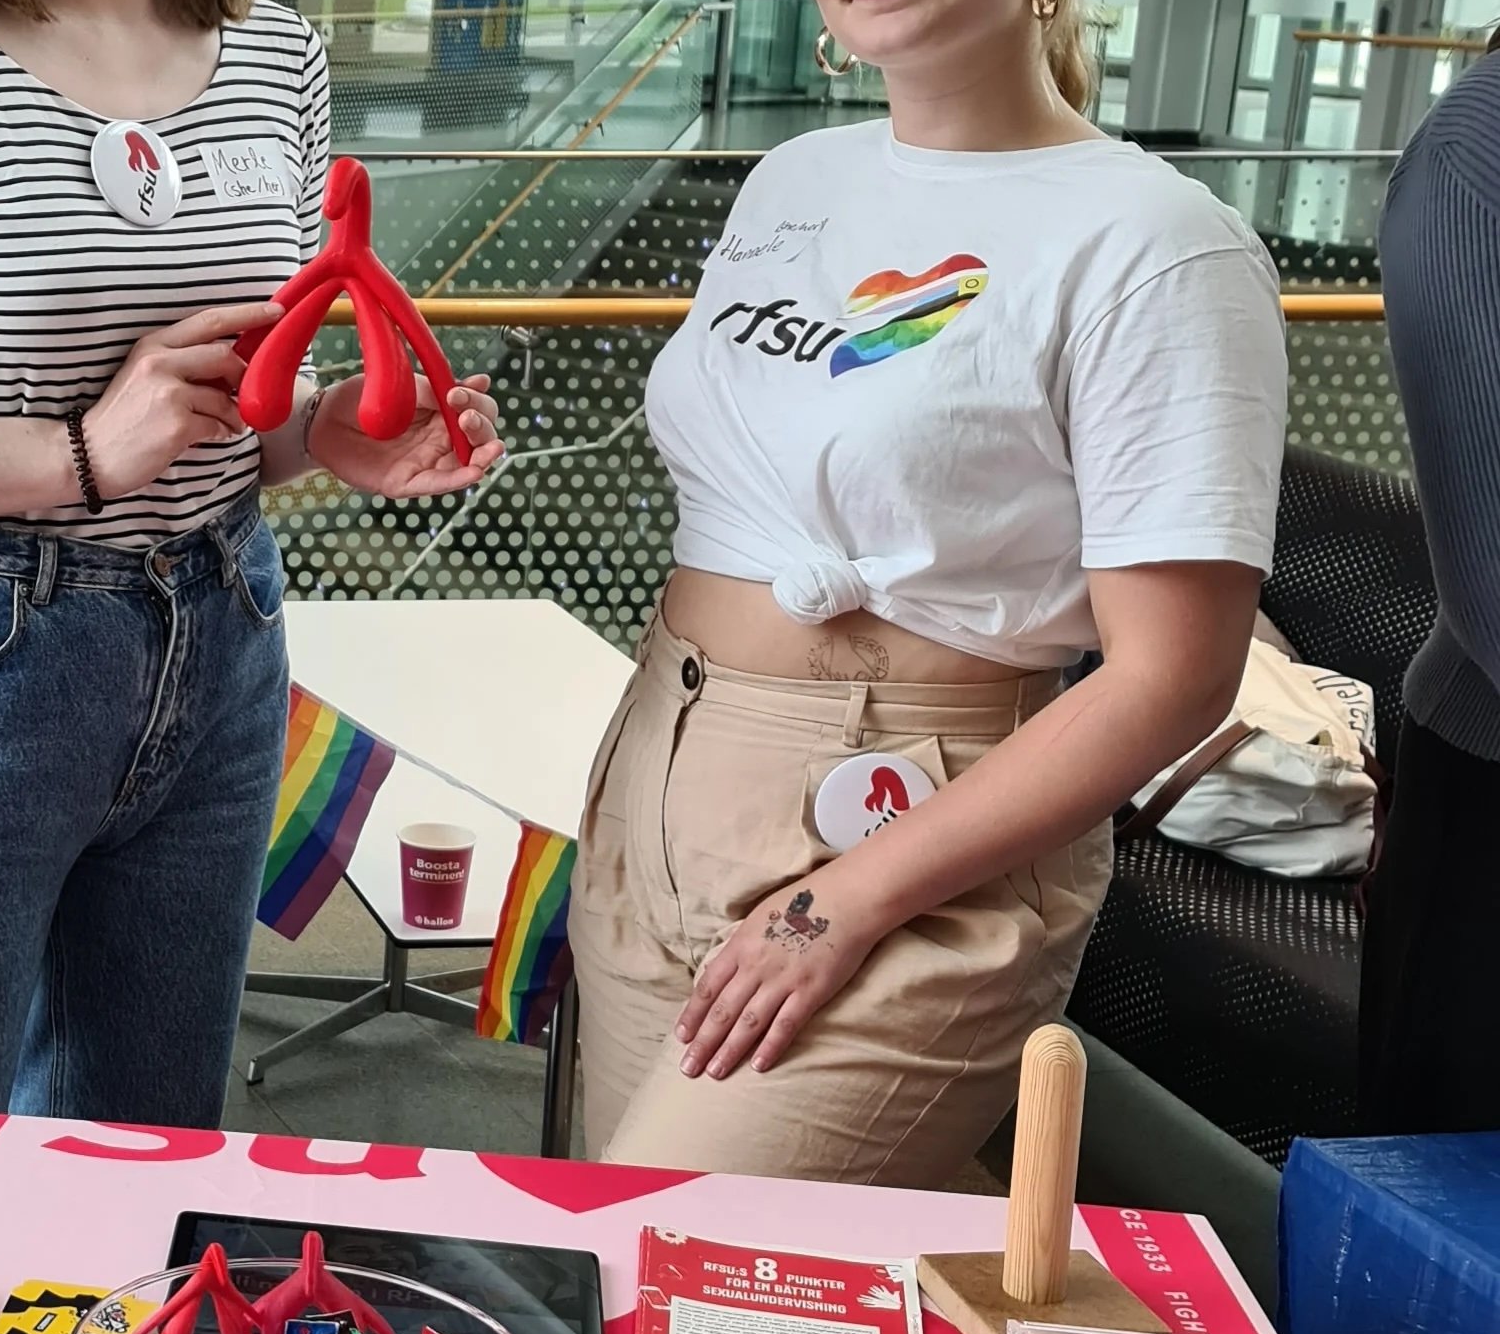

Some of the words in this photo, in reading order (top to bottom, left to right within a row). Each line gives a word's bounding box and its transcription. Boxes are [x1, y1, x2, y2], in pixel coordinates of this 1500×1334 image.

[137, 171, 157, 217] rfsu
[710, 299, 847, 363] rfsu
[409, 867, 465, 881] terminen!
[416, 858, 460, 870] Boosta
[1133, 1235, 1173, 1273] 1933
[703, 1260, 748, 1277] RFSU:S
[754, 1257, 778, 1281] 8
[786, 1274, 846, 1290] PUNKTER
[725, 1276, 751, 1289] FÖR
[754, 1280, 771, 1291] EN
[774, 1281, 824, 1300] BÄTTRE
[702, 1285, 847, 1315] SEXUALUNDERVISNING
